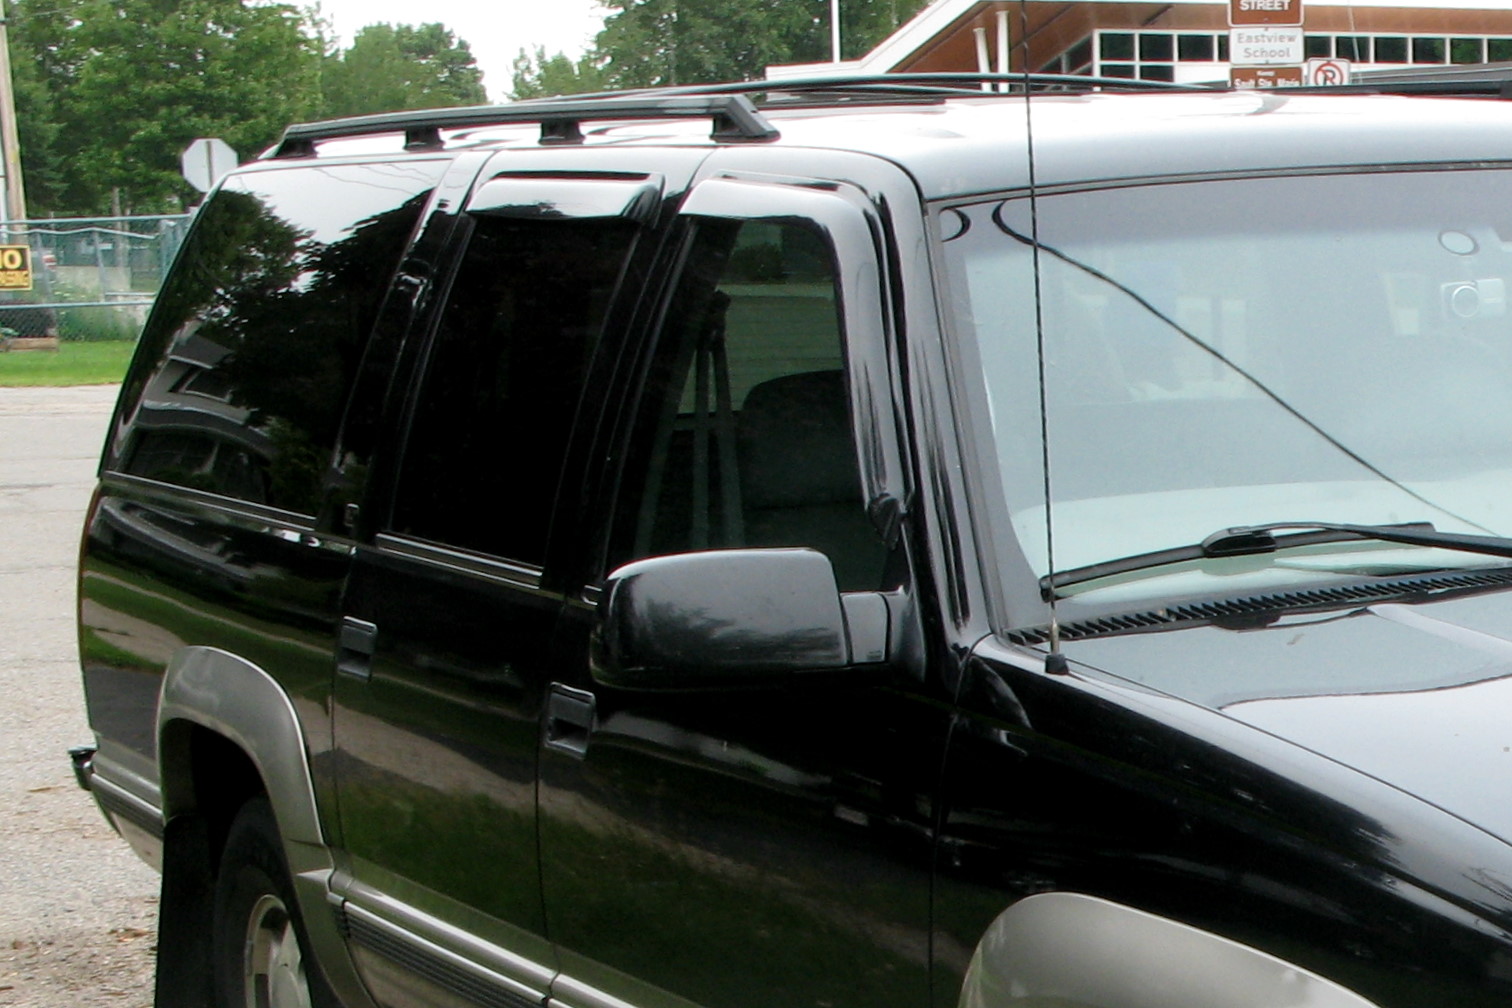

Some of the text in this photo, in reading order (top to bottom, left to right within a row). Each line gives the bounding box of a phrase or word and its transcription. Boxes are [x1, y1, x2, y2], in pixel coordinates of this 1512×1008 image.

[1239, 0, 1291, 11] STREET
[1237, 33, 1297, 44] Eastview
[1243, 47, 1291, 58] School
[0, 249, 22, 270] O
